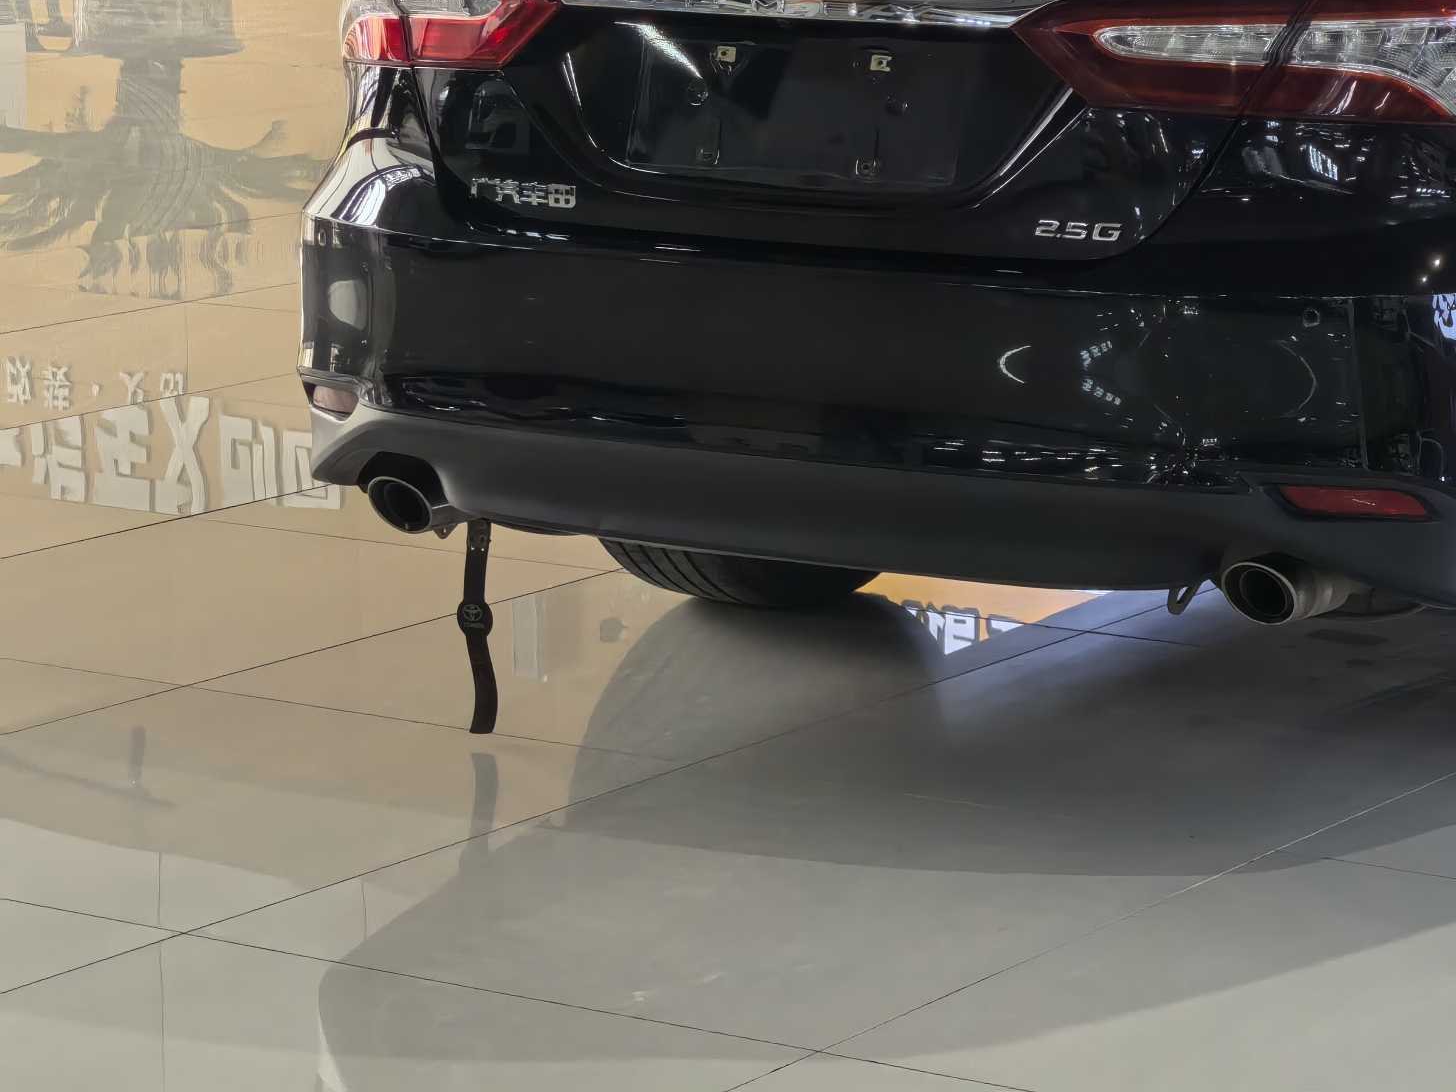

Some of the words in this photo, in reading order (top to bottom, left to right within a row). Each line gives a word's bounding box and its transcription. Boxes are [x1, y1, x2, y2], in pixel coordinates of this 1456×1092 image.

[470, 177, 577, 209] 广汽丰田
[1034, 219, 1123, 242] 2.5G
